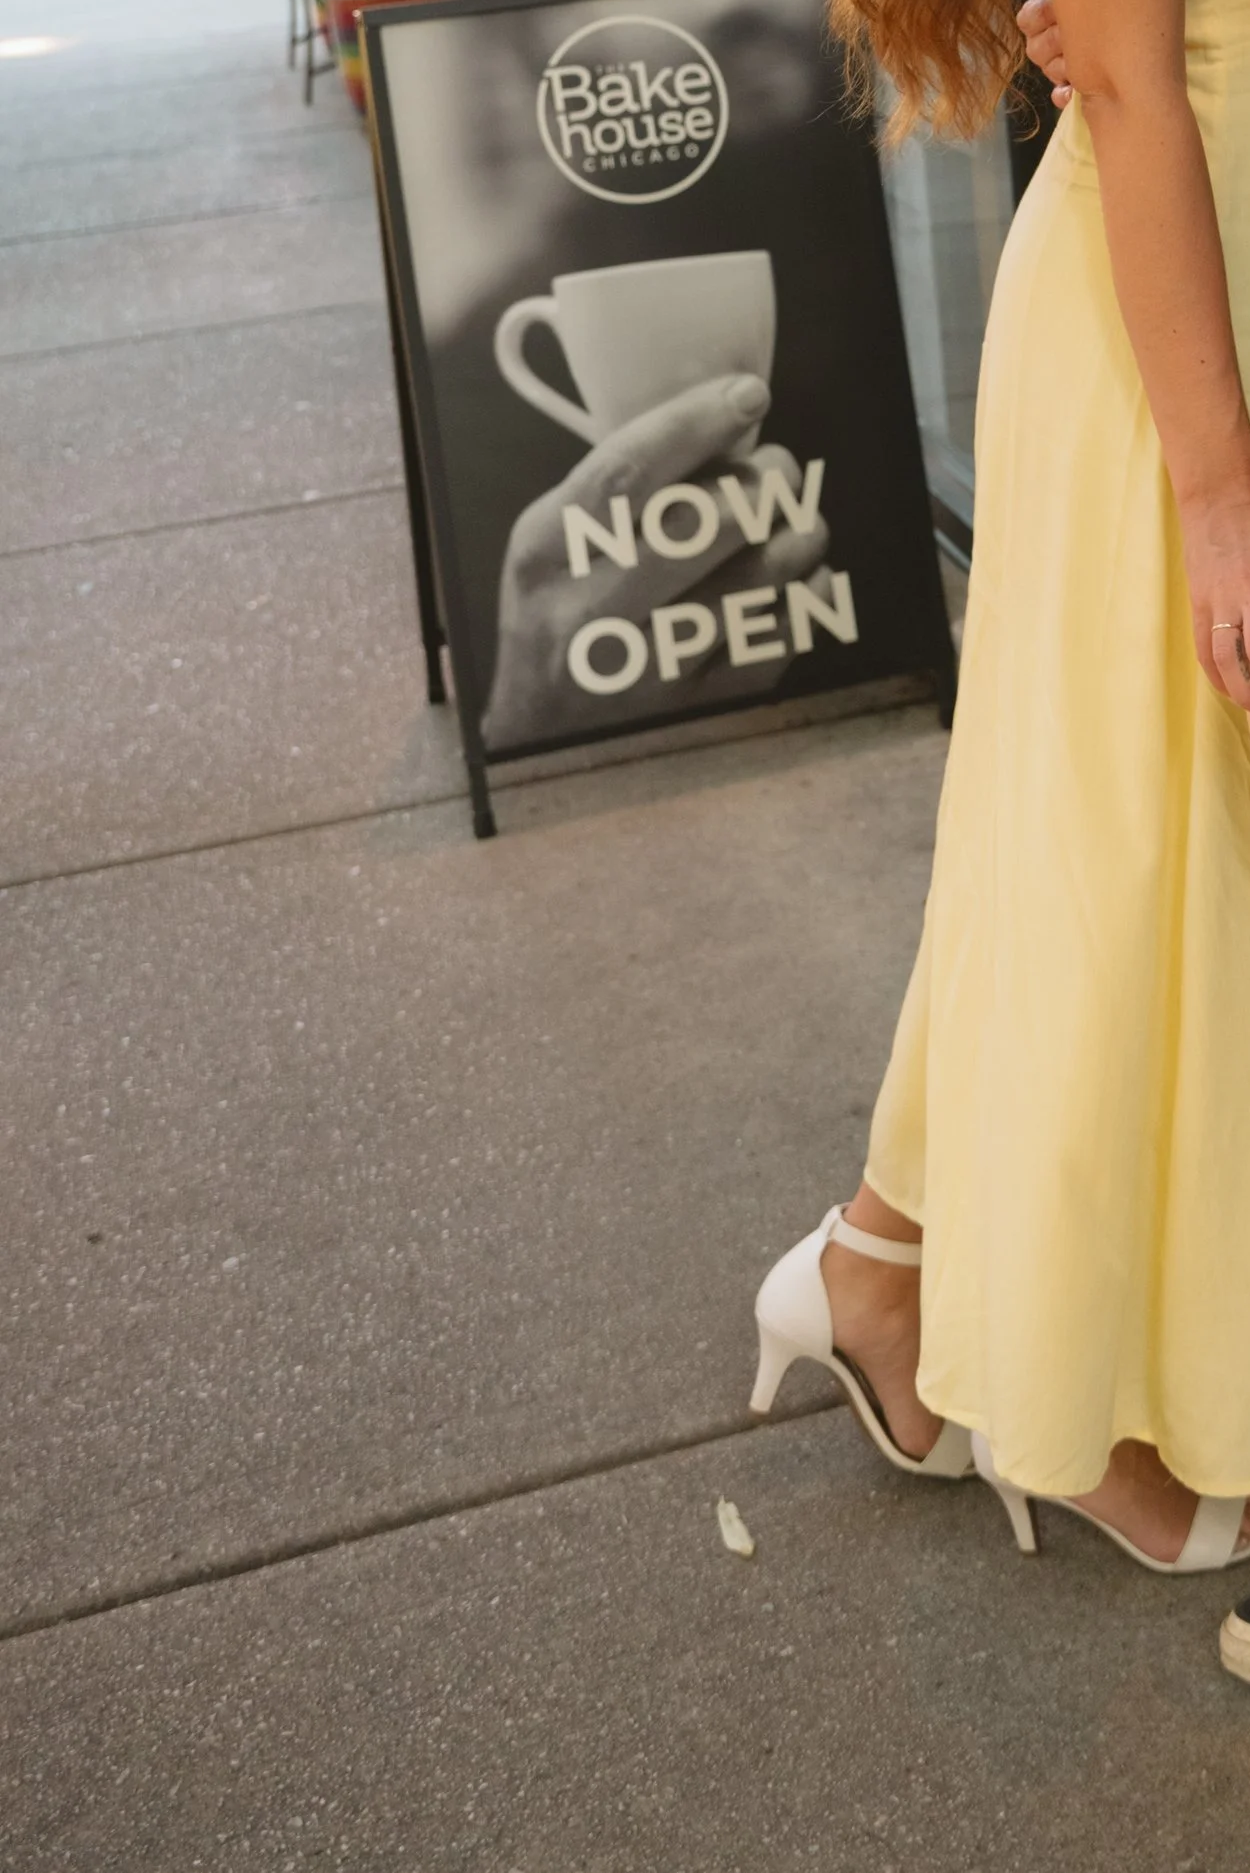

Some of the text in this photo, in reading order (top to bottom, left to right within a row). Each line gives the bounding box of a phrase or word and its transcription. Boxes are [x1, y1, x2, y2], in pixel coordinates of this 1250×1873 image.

[543, 60, 713, 123] Bake
[556, 106, 715, 158] house
[581, 141, 701, 174] CHICAGO
[561, 458, 826, 579] NOW
[566, 570, 859, 696] OPEN
